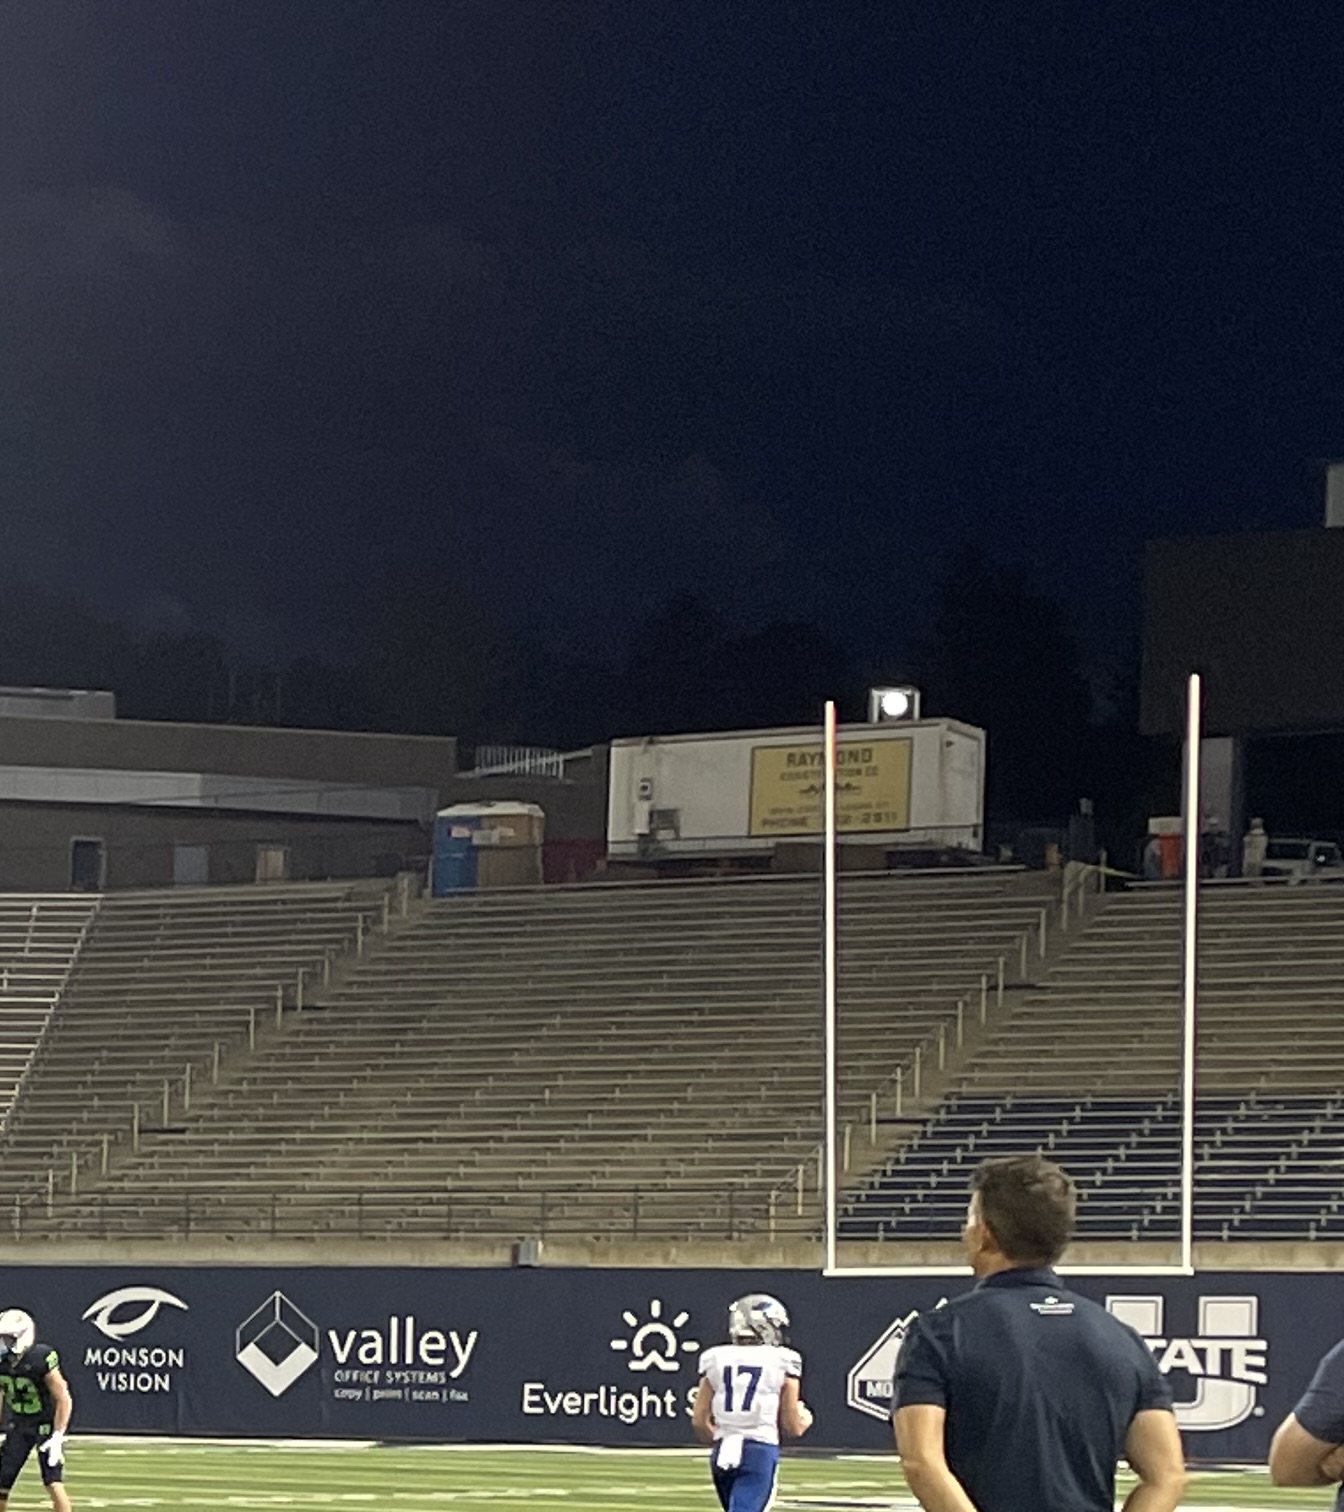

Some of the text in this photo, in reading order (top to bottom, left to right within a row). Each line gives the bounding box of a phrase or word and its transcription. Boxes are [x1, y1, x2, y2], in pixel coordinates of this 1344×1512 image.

[786, 748, 873, 768] RAYOND
[83, 1347, 185, 1368] MONSON
[328, 1315, 478, 1379] valley
[96, 1372, 170, 1392] VISION
[334, 1369, 447, 1385] OFFICE SYSTEMS
[723, 1365, 763, 1412] 17
[522, 1382, 677, 1425] Everlight
